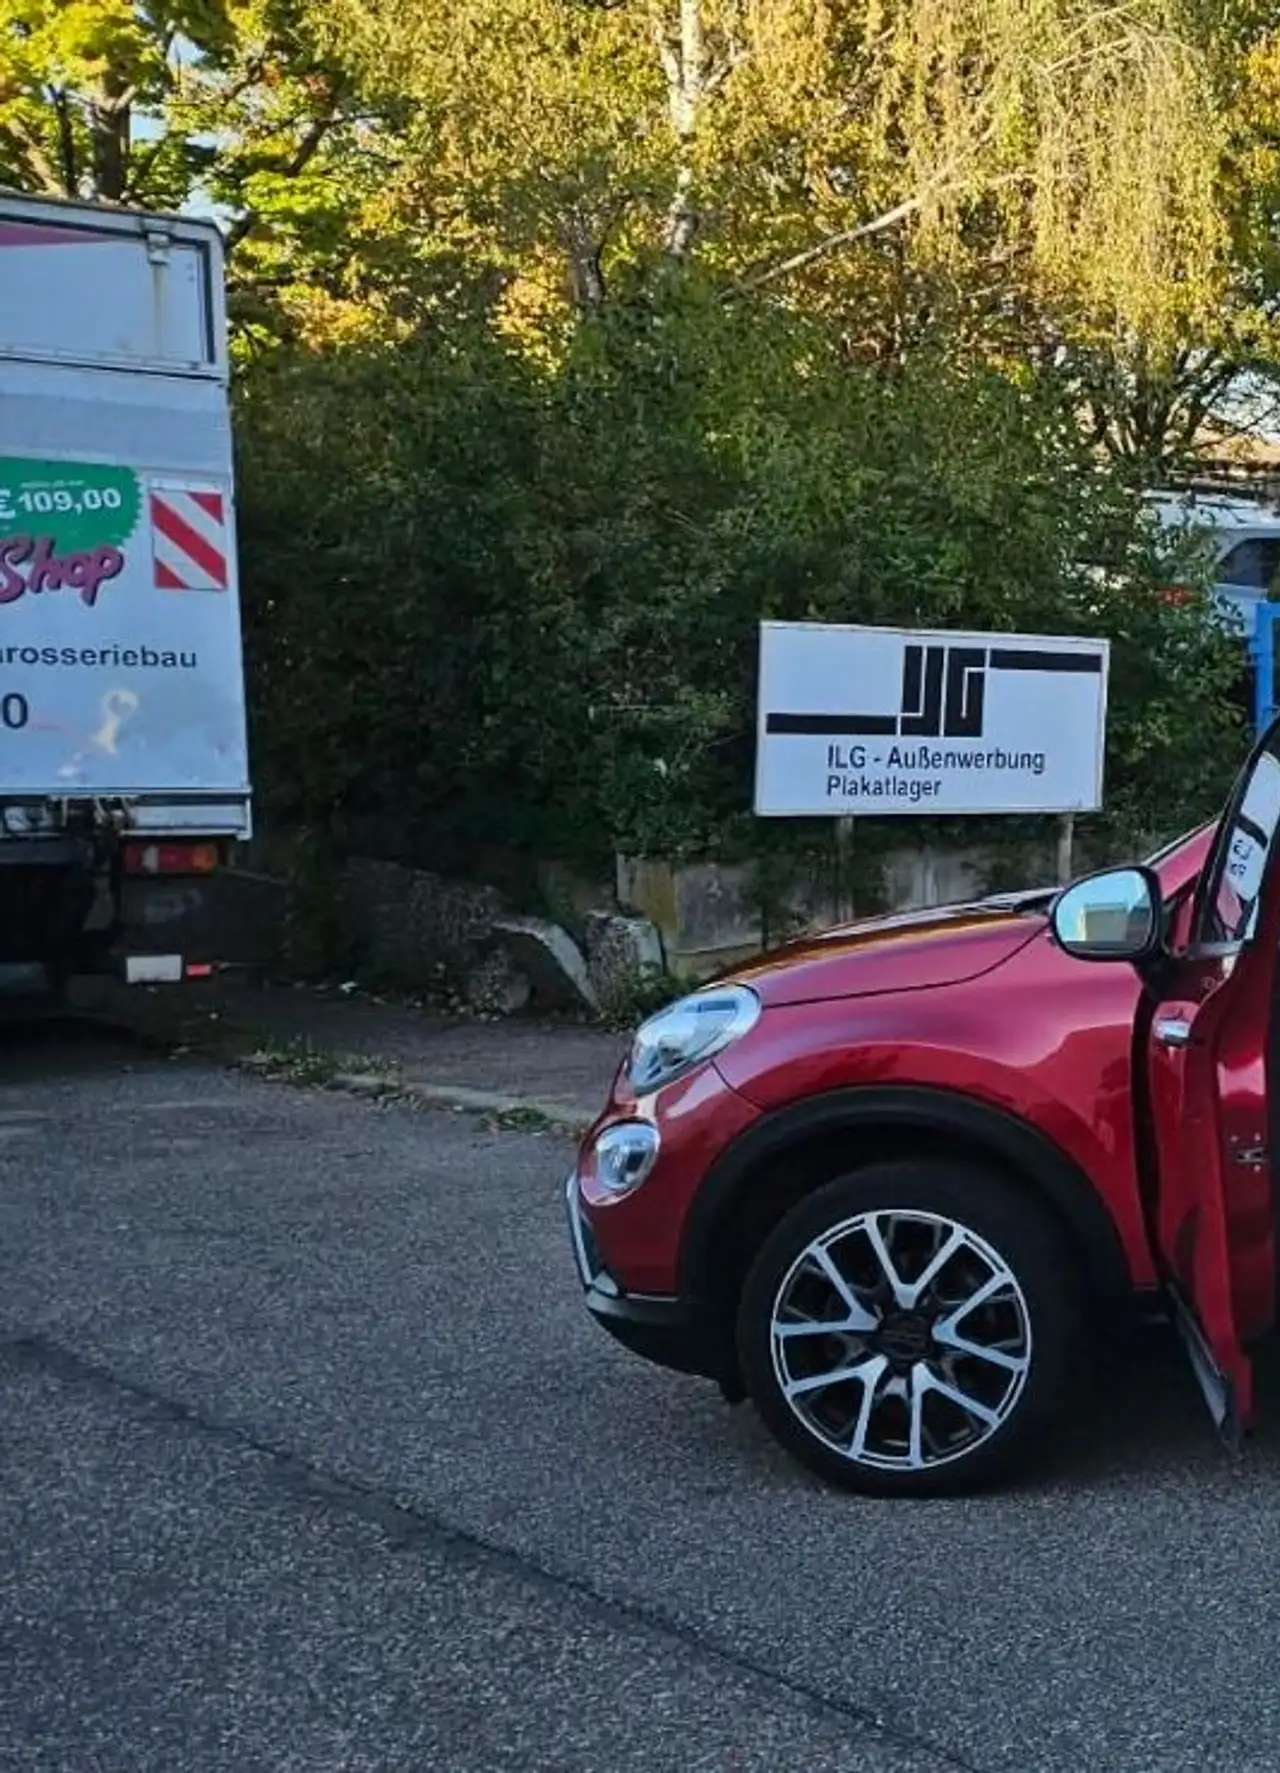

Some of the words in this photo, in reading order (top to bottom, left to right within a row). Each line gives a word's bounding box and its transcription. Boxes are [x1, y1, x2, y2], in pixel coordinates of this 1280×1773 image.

[18, 488, 122, 515] 109,00
[0, 536, 125, 607] Shop
[827, 745, 867, 770] ILG
[887, 745, 1046, 775] Außenwerbung
[827, 775, 942, 802] Plakatlager
